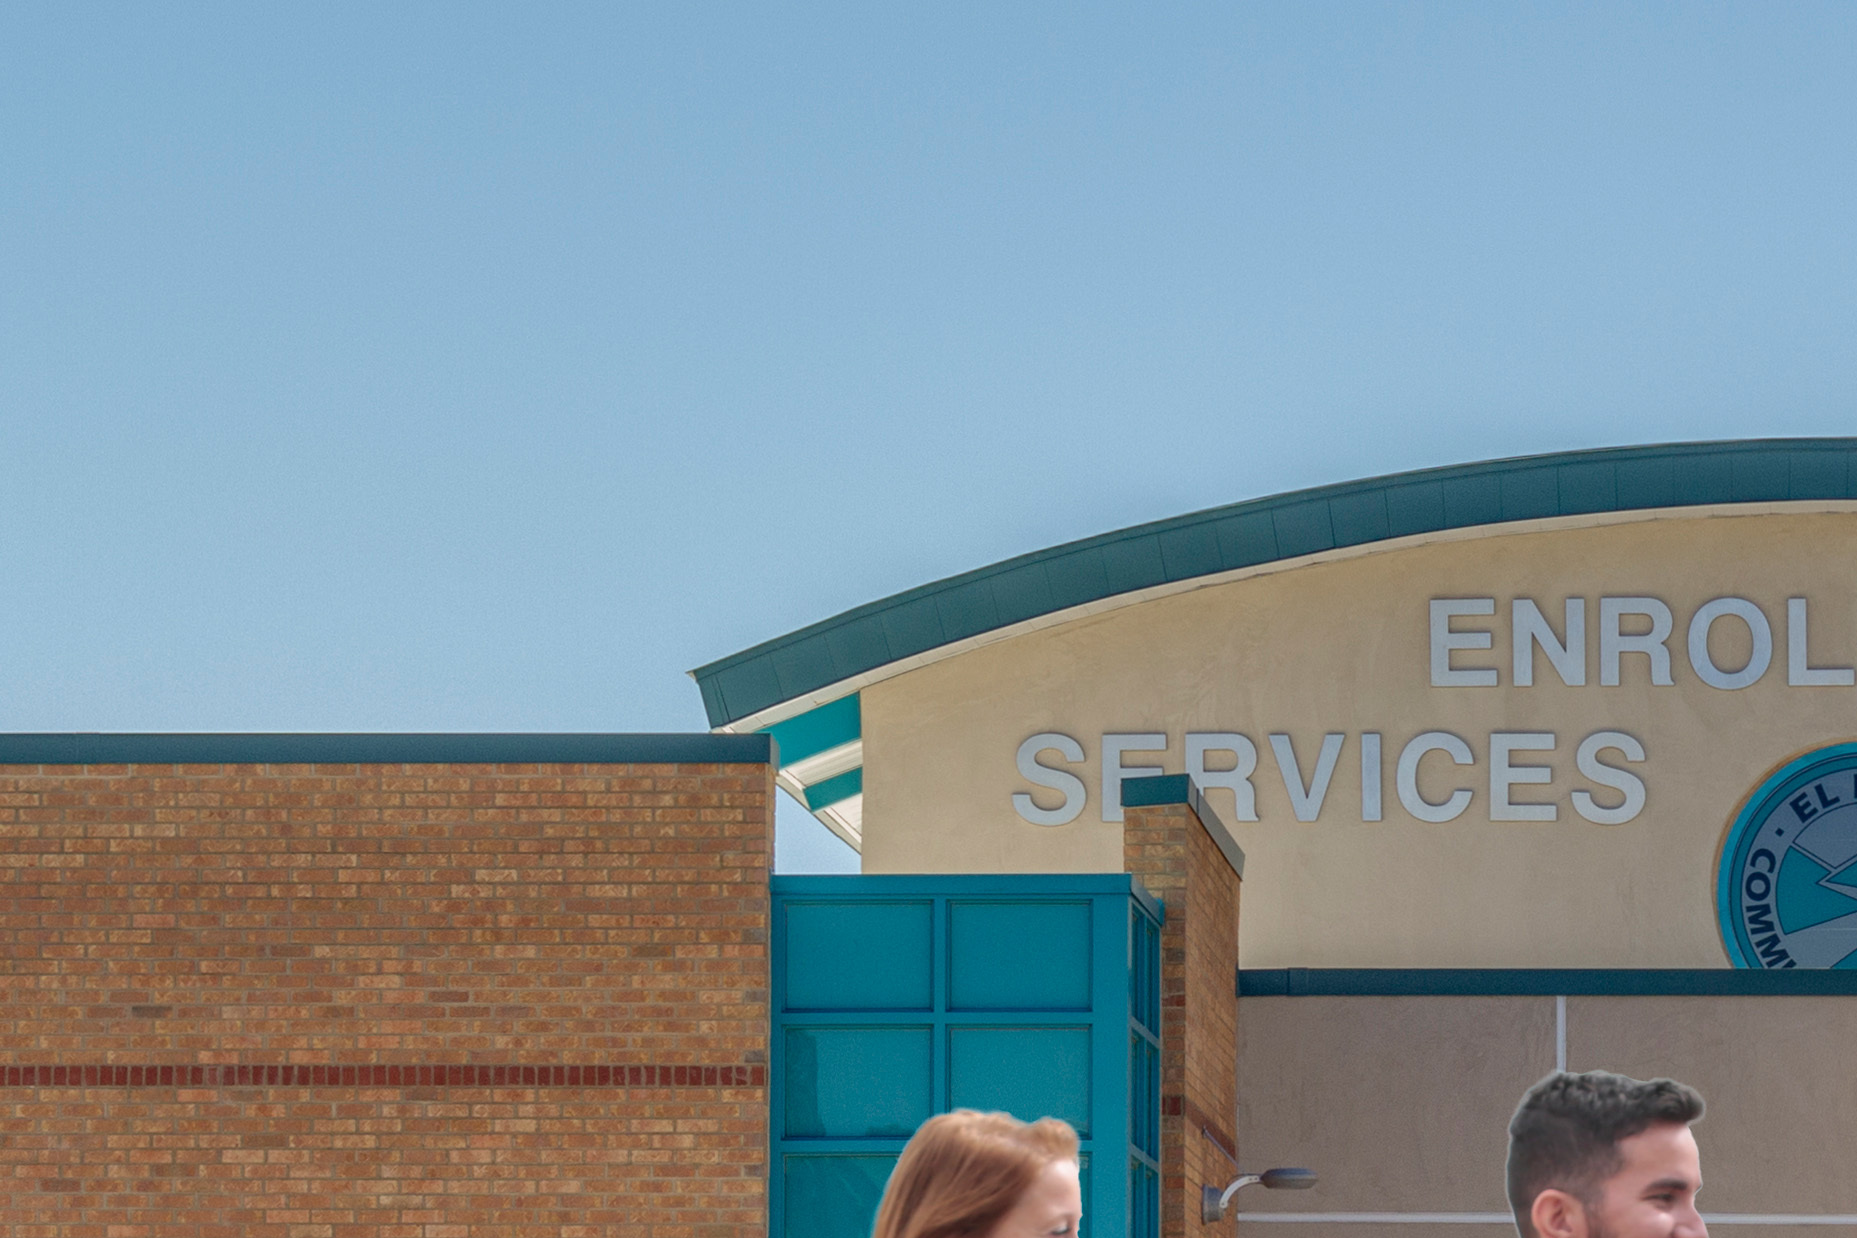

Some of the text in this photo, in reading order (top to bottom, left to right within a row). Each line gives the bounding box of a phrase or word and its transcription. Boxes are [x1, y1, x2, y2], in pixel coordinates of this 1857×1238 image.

[1011, 731, 1646, 826] SERVICES
[1789, 783, 1840, 823] EL
[1745, 848, 1797, 968] COMM
